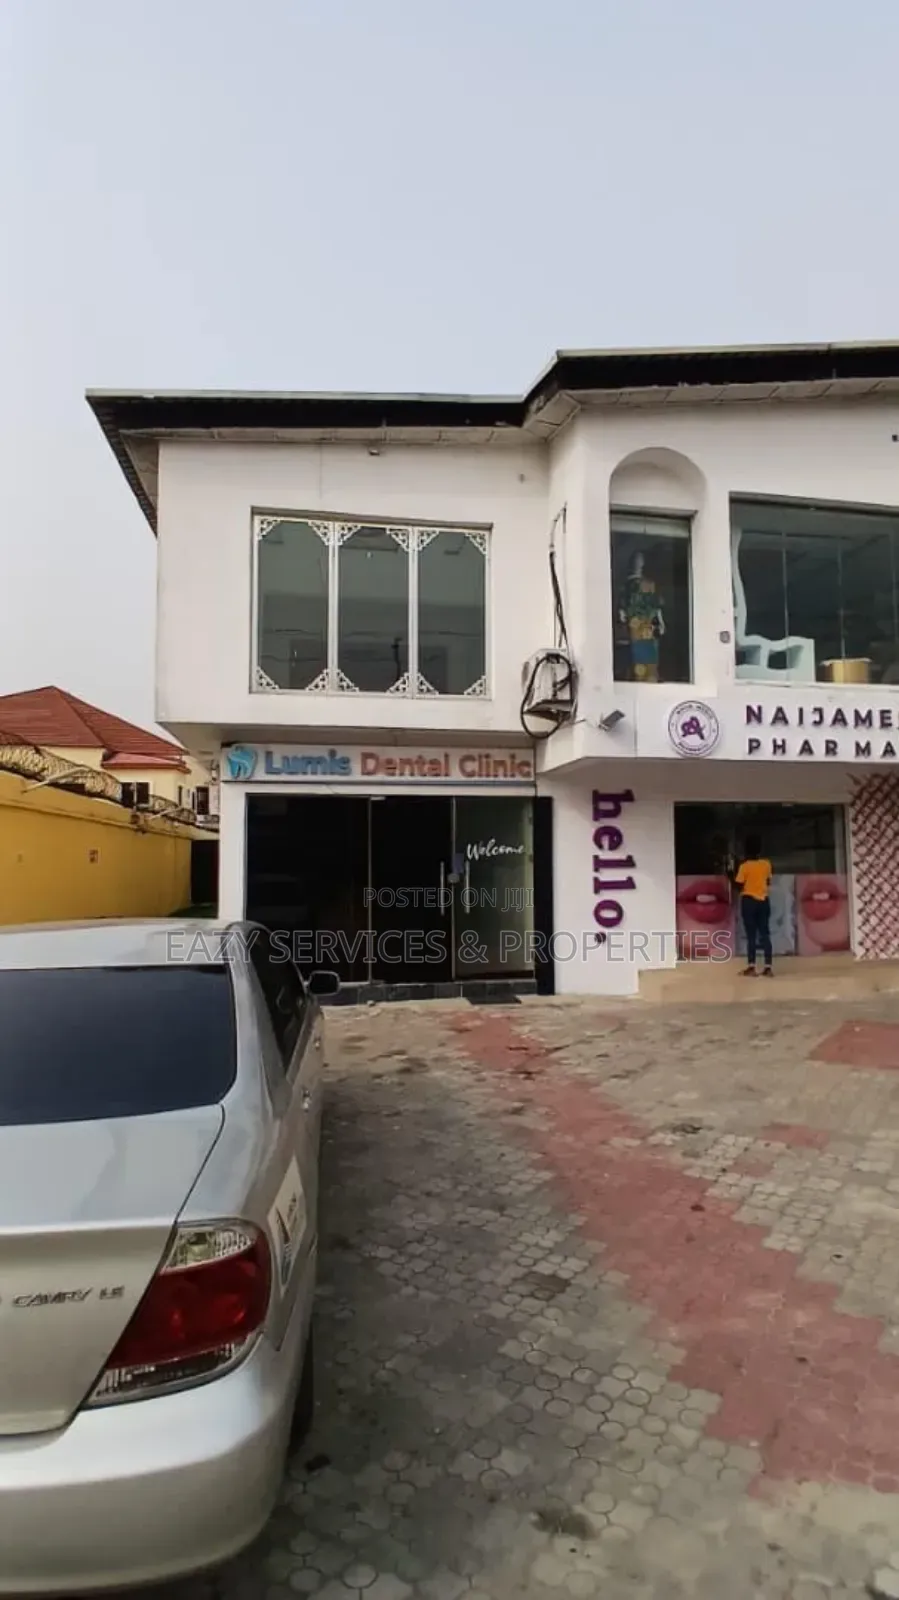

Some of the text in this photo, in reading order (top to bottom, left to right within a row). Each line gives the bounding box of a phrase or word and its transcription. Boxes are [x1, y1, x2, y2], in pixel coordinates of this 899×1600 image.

[745, 704, 899, 731] NAIJAME
[747, 737, 897, 759] PHARMA
[264, 748, 533, 779] Lumis Dental Clinic
[467, 838, 525, 861] Welcome
[592, 789, 636, 945] hello.
[12, 1285, 125, 1308] CAMRY LE
